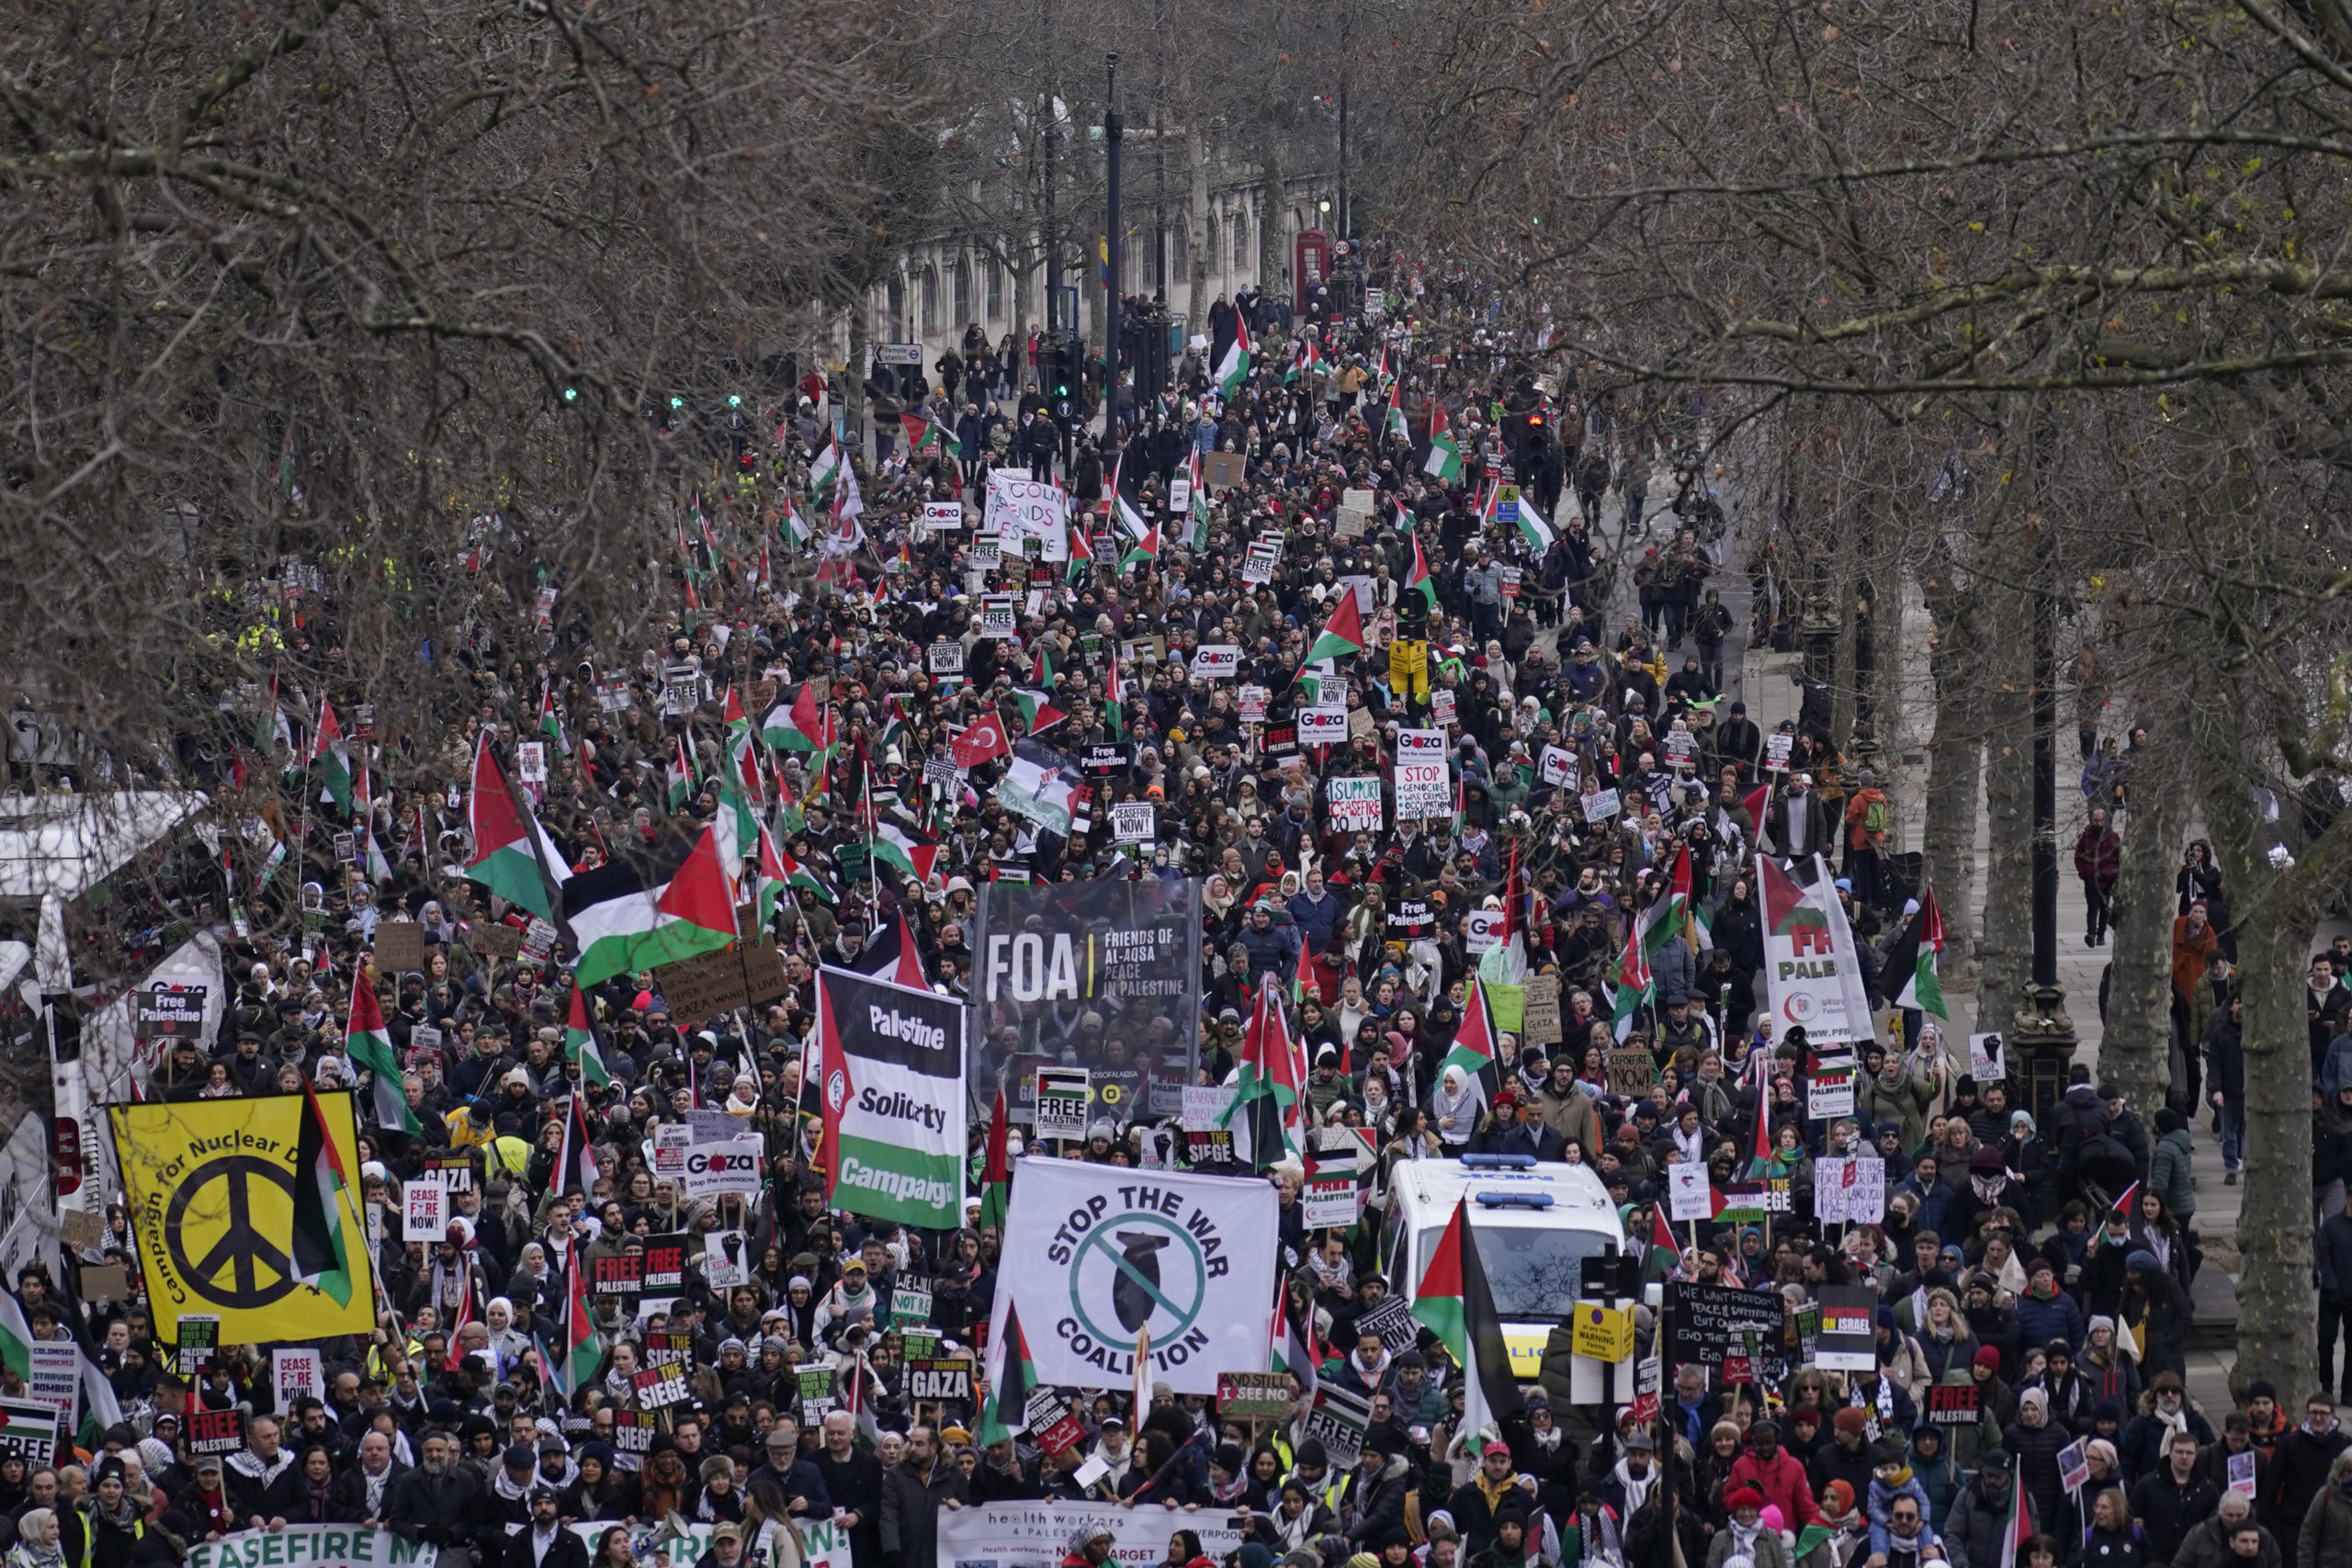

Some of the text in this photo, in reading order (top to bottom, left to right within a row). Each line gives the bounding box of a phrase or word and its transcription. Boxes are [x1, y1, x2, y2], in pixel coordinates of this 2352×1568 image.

[927, 507, 958, 518] Gza
[974, 547, 999, 557] FREE
[1246, 559, 1272, 572] FREE
[1030, 570, 1051, 581] FREE
[983, 614, 1011, 623] FREE
[932, 647, 961, 656] CEASEFIRE
[1198, 651, 1233, 663] Gza
[934, 656, 959, 667] NOW!
[1321, 680, 1346, 690] CEASEFIRE
[667, 686, 695, 700] FREE
[1323, 691, 1343, 704] NOW!
[1301, 713, 1344, 727] Gza
[1268, 728, 1294, 744] FREE
[1400, 734, 1442, 748] Gza
[1092, 747, 1115, 757] Free
[1268, 741, 1295, 752] PALESTINE
[1081, 755, 1126, 768] Palestine
[925, 765, 955, 781] CEASEFIRE
[1406, 767, 1440, 781] STOP
[1336, 779, 1378, 799] SUPPORT
[1404, 783, 1445, 792] GENOCIDE
[1423, 792, 1448, 800] CRIMES
[1115, 807, 1152, 818] CEASEFIRE
[1330, 800, 1380, 818] CEASEFIRE
[1406, 801, 1452, 810] OCCUPATION
[1589, 805, 1618, 821] HUMANITY
[1119, 818, 1148, 832] NOW!
[1401, 902, 1426, 913] Free
[1387, 911, 1435, 926] Palestine
[1104, 928, 1173, 948] FRIENDS OF
[1104, 945, 1156, 964] AL-AQSA
[986, 933, 1079, 1002] FOA
[1104, 964, 1141, 979] PEACE
[1103, 979, 1183, 996] IN PALESTINE
[156, 995, 186, 1009] Free
[676, 976, 779, 1019] GAZA WANTS LIVE
[1527, 993, 1552, 1001] STOP
[140, 1009, 200, 1023] Palestine
[870, 1005, 944, 1051] Palstine
[1529, 1020, 1553, 1029] GAZA
[1611, 1055, 1648, 1066] CEASEFIRE
[1615, 1067, 1649, 1087] NOW!
[1815, 1073, 1847, 1088] FREE
[1810, 1086, 1852, 1097] PALESTINE
[1038, 1099, 1084, 1117] FREE
[1038, 1115, 1084, 1125] PALESTINE
[187, 1130, 279, 1157] Nuclear
[1188, 1132, 1229, 1145] END THE
[1189, 1145, 1231, 1163] SIEGE
[424, 1158, 471, 1168] STOP BOMBING
[687, 1154, 753, 1174] Gza
[156, 1154, 186, 1187] for
[841, 1157, 955, 1209] Campaign
[1312, 1178, 1350, 1193] FREE
[1771, 1179, 1790, 1191] THE
[410, 1190, 437, 1201] CEASE
[1306, 1192, 1354, 1203] PALESTINE
[1675, 1196, 1706, 1204] Ceasefire
[1763, 1192, 1792, 1211] EGE
[410, 1202, 437, 1214] FRE
[410, 1216, 439, 1229] NOW!
[1049, 1186, 1229, 1279] STOP THE WAR
[147, 1192, 187, 1304] Campaign
[647, 1247, 682, 1271] FREE
[595, 1258, 640, 1280] FREE
[645, 1271, 682, 1286] PALESTINE
[895, 1273, 932, 1293] WE WILL
[596, 1280, 641, 1292] PALESTINE
[1679, 1286, 1700, 1299] WE
[1703, 1289, 1729, 1301] WANT
[893, 1294, 930, 1314] NOT BE
[1690, 1303, 1720, 1314] PEACE
[1823, 1307, 1870, 1318] SANCTIONS
[182, 1323, 200, 1332] FROM
[1693, 1315, 1713, 1326] BUT
[1823, 1317, 1871, 1331] ON ISRAEL
[647, 1336, 691, 1348] END THE
[906, 1337, 935, 1347] FROM THE
[1578, 1331, 1615, 1345] WARNING
[1678, 1329, 1726, 1343] END THE
[182, 1339, 193, 1348] THE
[1057, 1317, 1209, 1376] COALIION
[1586, 1341, 1606, 1352] Parking
[33, 1348, 74, 1356] COLONISED
[180, 1348, 213, 1357] PALESTINE
[1700, 1348, 1722, 1362] END
[180, 1356, 206, 1365] WILL BE
[281, 1358, 311, 1371] CEASE
[933, 1361, 968, 1371] BOMBING
[180, 1365, 196, 1374] FREE
[634, 1361, 682, 1389] END THE
[799, 1371, 831, 1382] FROM THE
[33, 1372, 74, 1382] STARVED
[281, 1372, 312, 1386] FRE
[1219, 1374, 1286, 1387] AND STILL
[33, 1383, 74, 1393] BOMBED
[911, 1371, 968, 1398] GAZA
[282, 1387, 312, 1401] NOW!
[638, 1376, 689, 1410] SIEGE
[1222, 1387, 1288, 1401] I SEE NO
[1931, 1386, 1979, 1411] FREE
[803, 1396, 836, 1407] PALESTINE
[804, 1407, 820, 1416] WILL
[1930, 1411, 1978, 1423] PALESTINE
[187, 1412, 242, 1440] FREE
[616, 1411, 656, 1427] END THE
[805, 1416, 821, 1426] FREE
[1031, 1405, 1069, 1437] PALESTINE
[1307, 1410, 1363, 1447] FREE
[191, 1437, 242, 1453] PALESTINE
[1305, 1426, 1358, 1455] PALESTINE
[1110, 1550, 1156, 1561] ARGET
